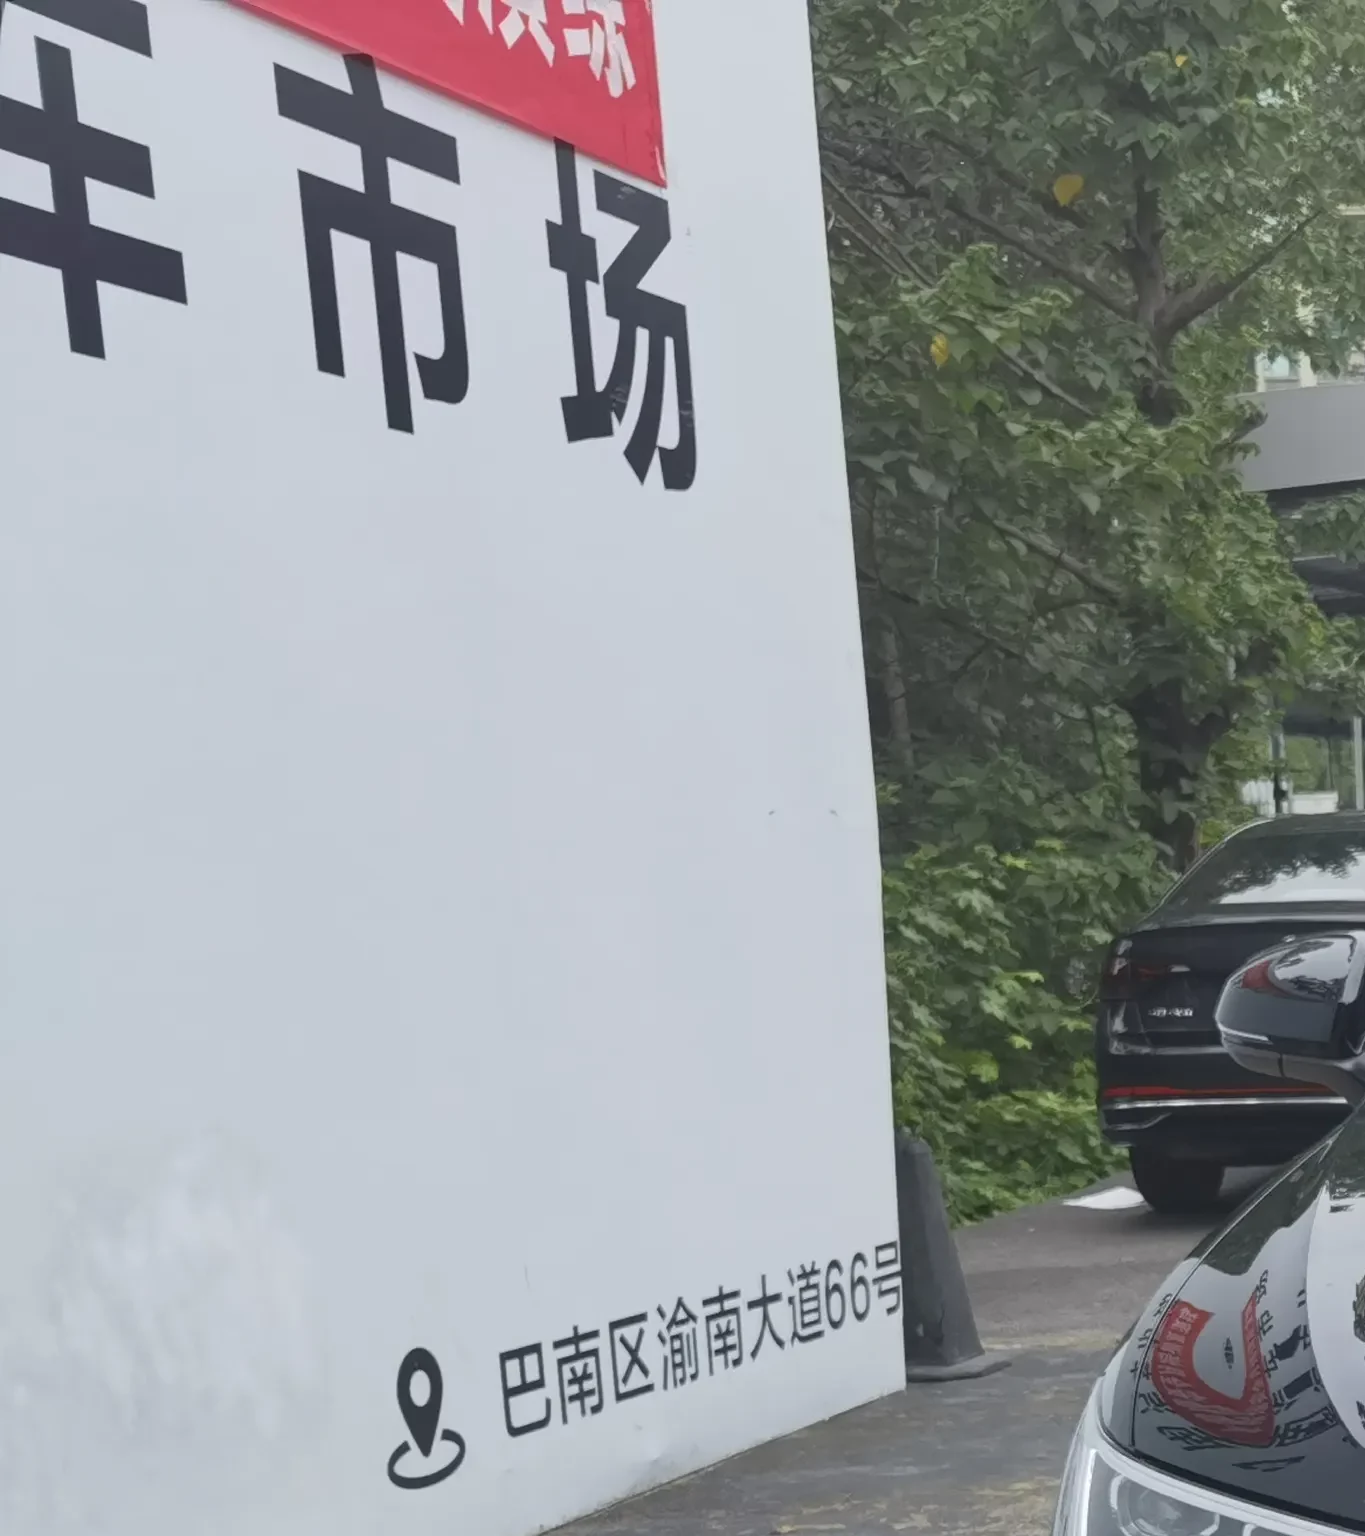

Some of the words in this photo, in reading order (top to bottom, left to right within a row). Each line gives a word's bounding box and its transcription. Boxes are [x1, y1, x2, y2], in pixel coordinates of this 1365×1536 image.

[499, 1240, 902, 1438] 巴南区渝南大道66号
